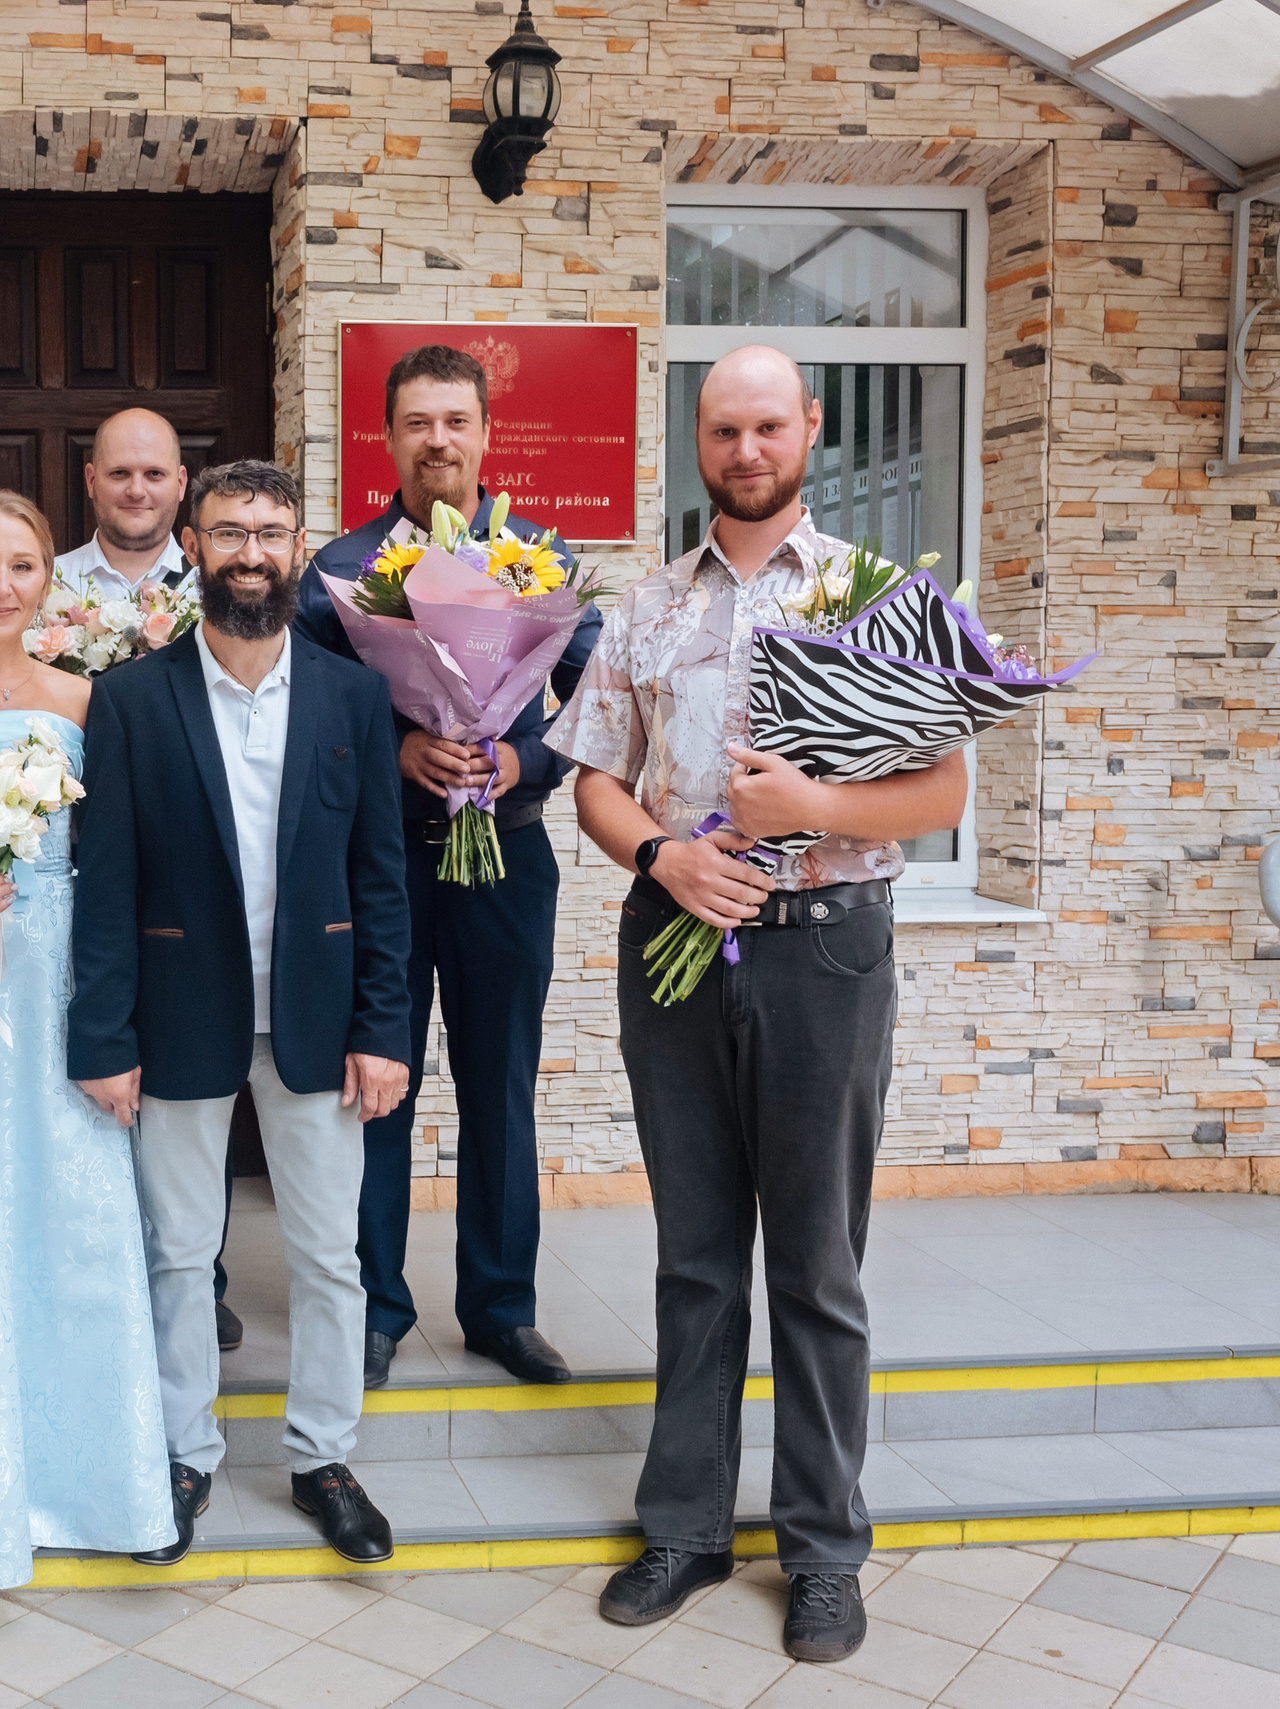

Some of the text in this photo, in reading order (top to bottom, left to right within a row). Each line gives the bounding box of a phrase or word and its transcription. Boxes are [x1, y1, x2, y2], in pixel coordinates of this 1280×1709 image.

[493, 419, 553, 431] Федерация
[352, 430, 625, 445] Управ гражданского состояния
[484, 446, 548, 457] рского края
[495, 472, 537, 486] ЗАГС
[555, 493, 610, 509] района
[512, 610, 532, 618] SPE
[466, 639, 494, 655] love
